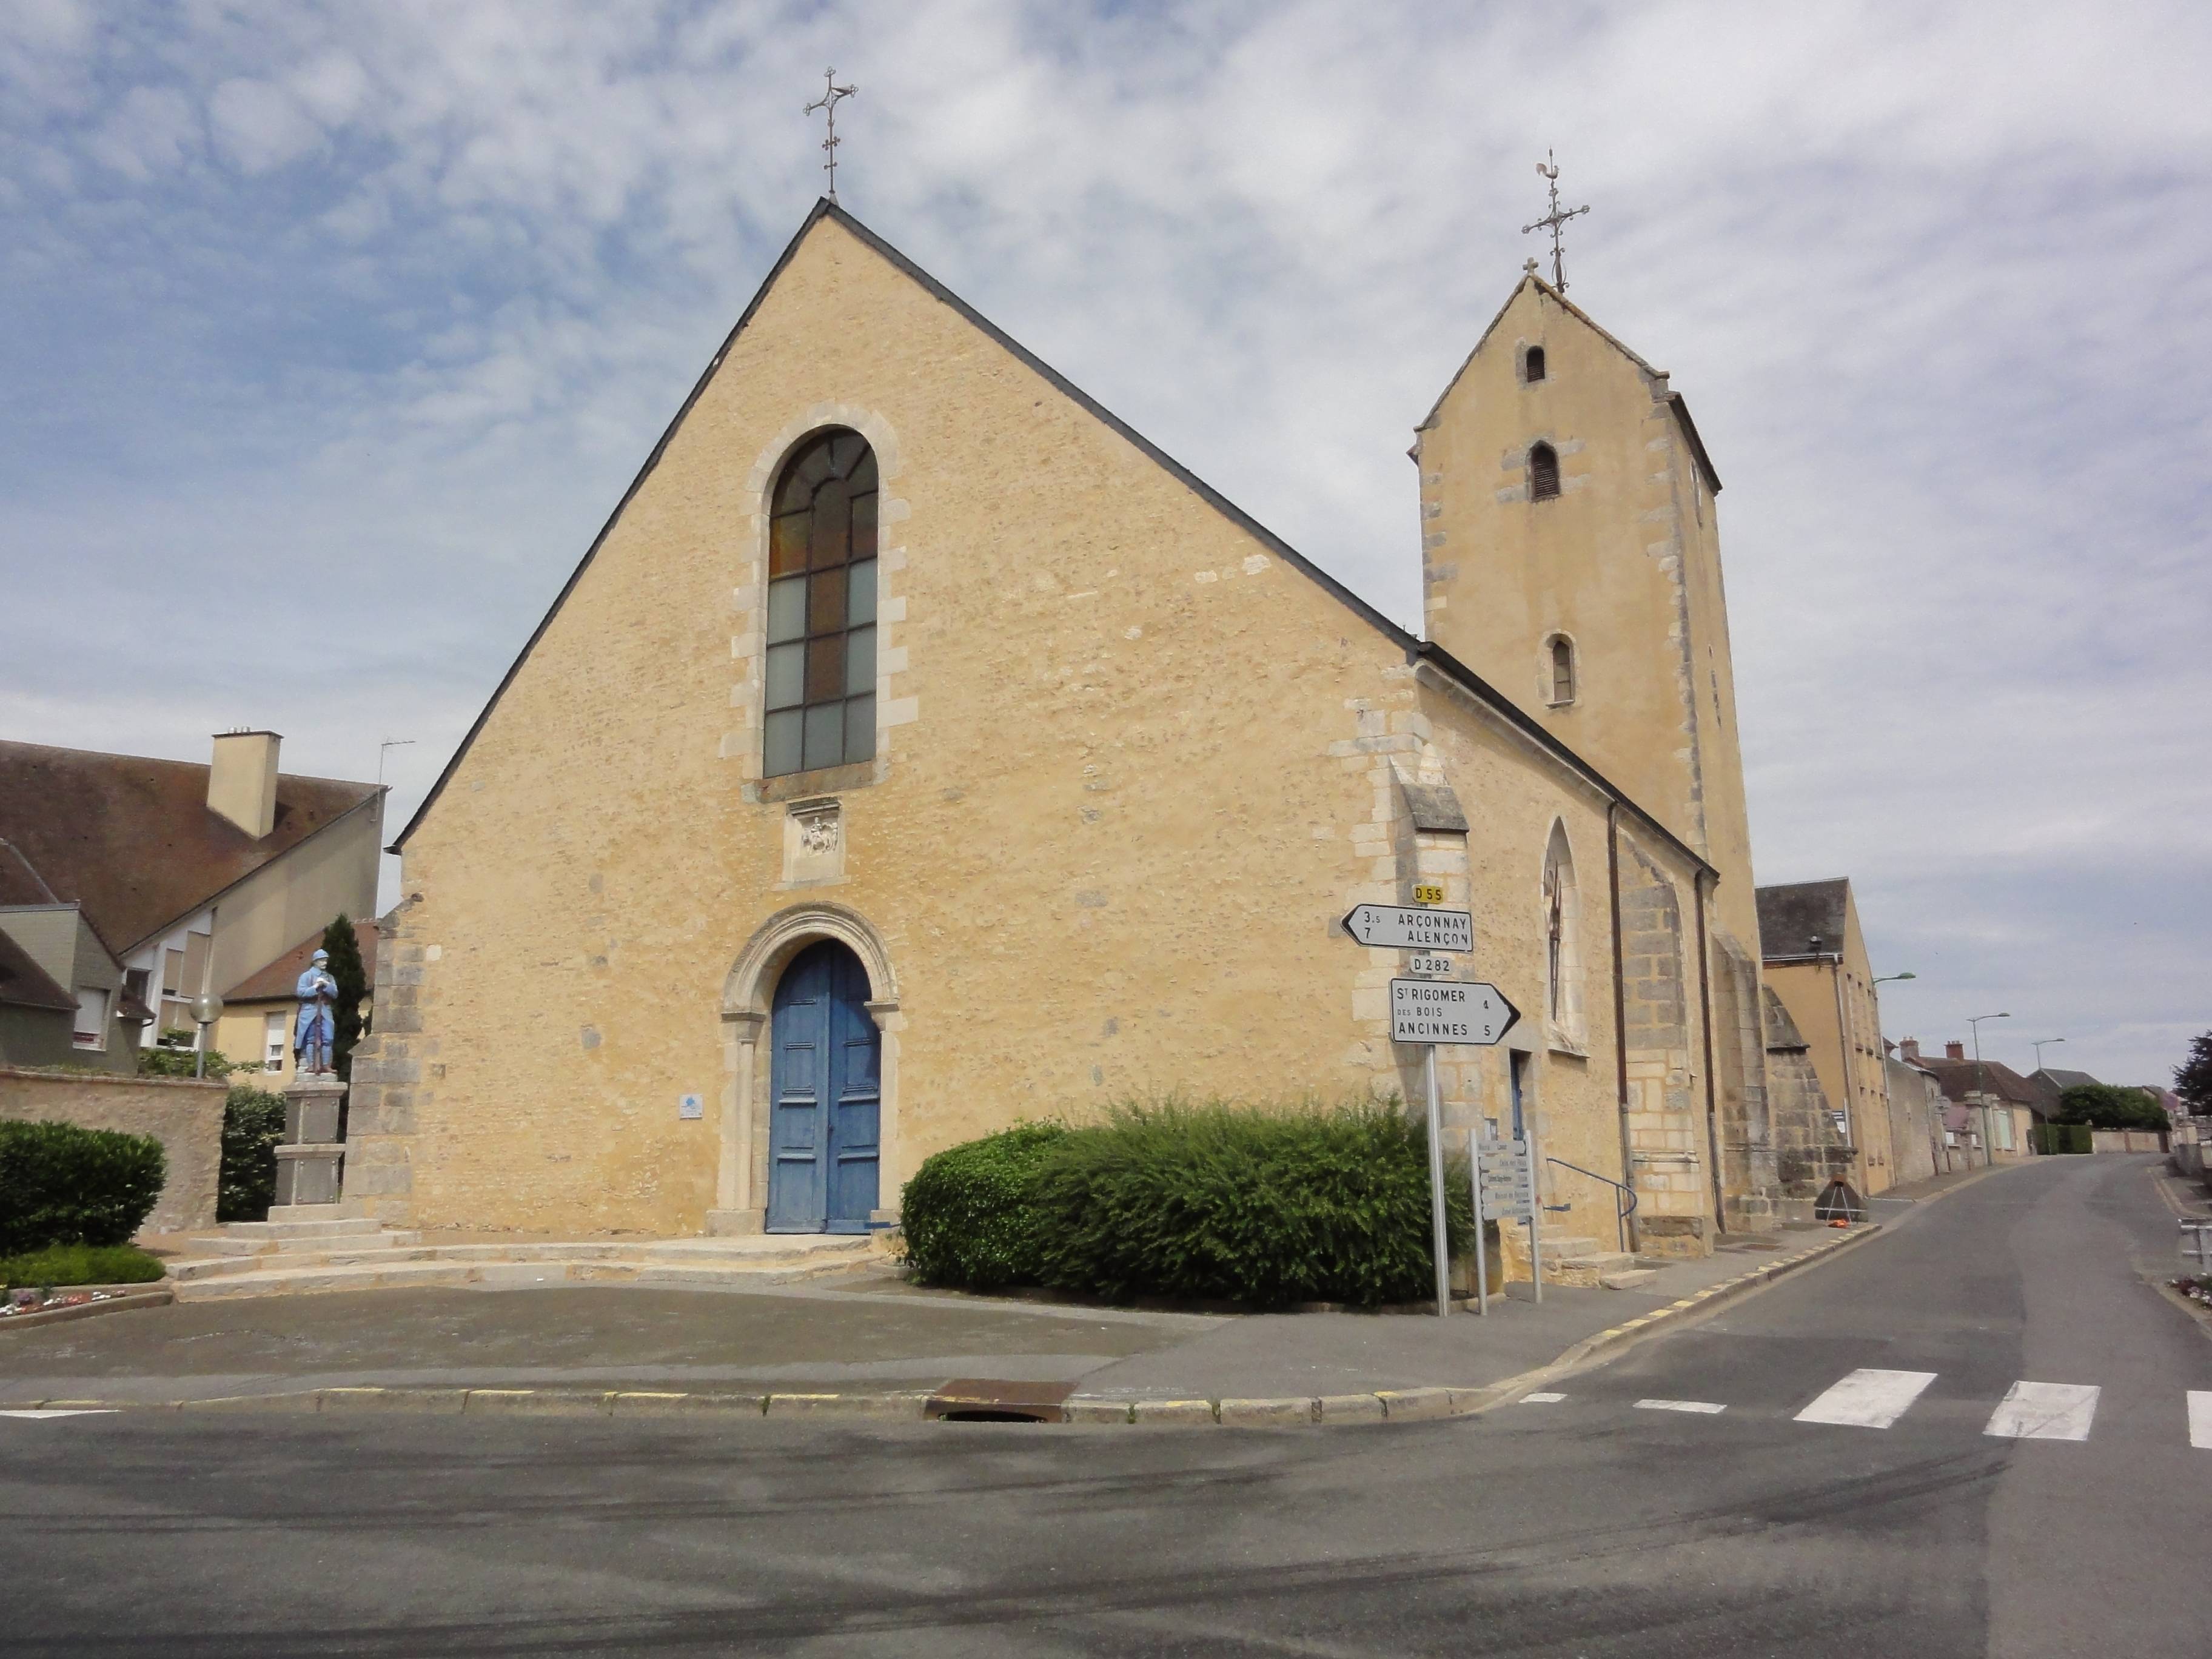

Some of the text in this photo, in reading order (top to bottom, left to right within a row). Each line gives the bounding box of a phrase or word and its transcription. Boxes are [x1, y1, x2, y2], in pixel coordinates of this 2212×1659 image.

[1416, 888, 1441, 900] D 55
[1364, 911, 1466, 930] 3.5 ARÇONNAY
[1365, 928, 1467, 945] 7 ALENÇON
[1415, 959, 1449, 971] D 282
[1412, 988, 1465, 1002] RIGOMER
[1416, 1007, 1442, 1017] BOIS
[1399, 1022, 1490, 1036] ANCINNES 5
